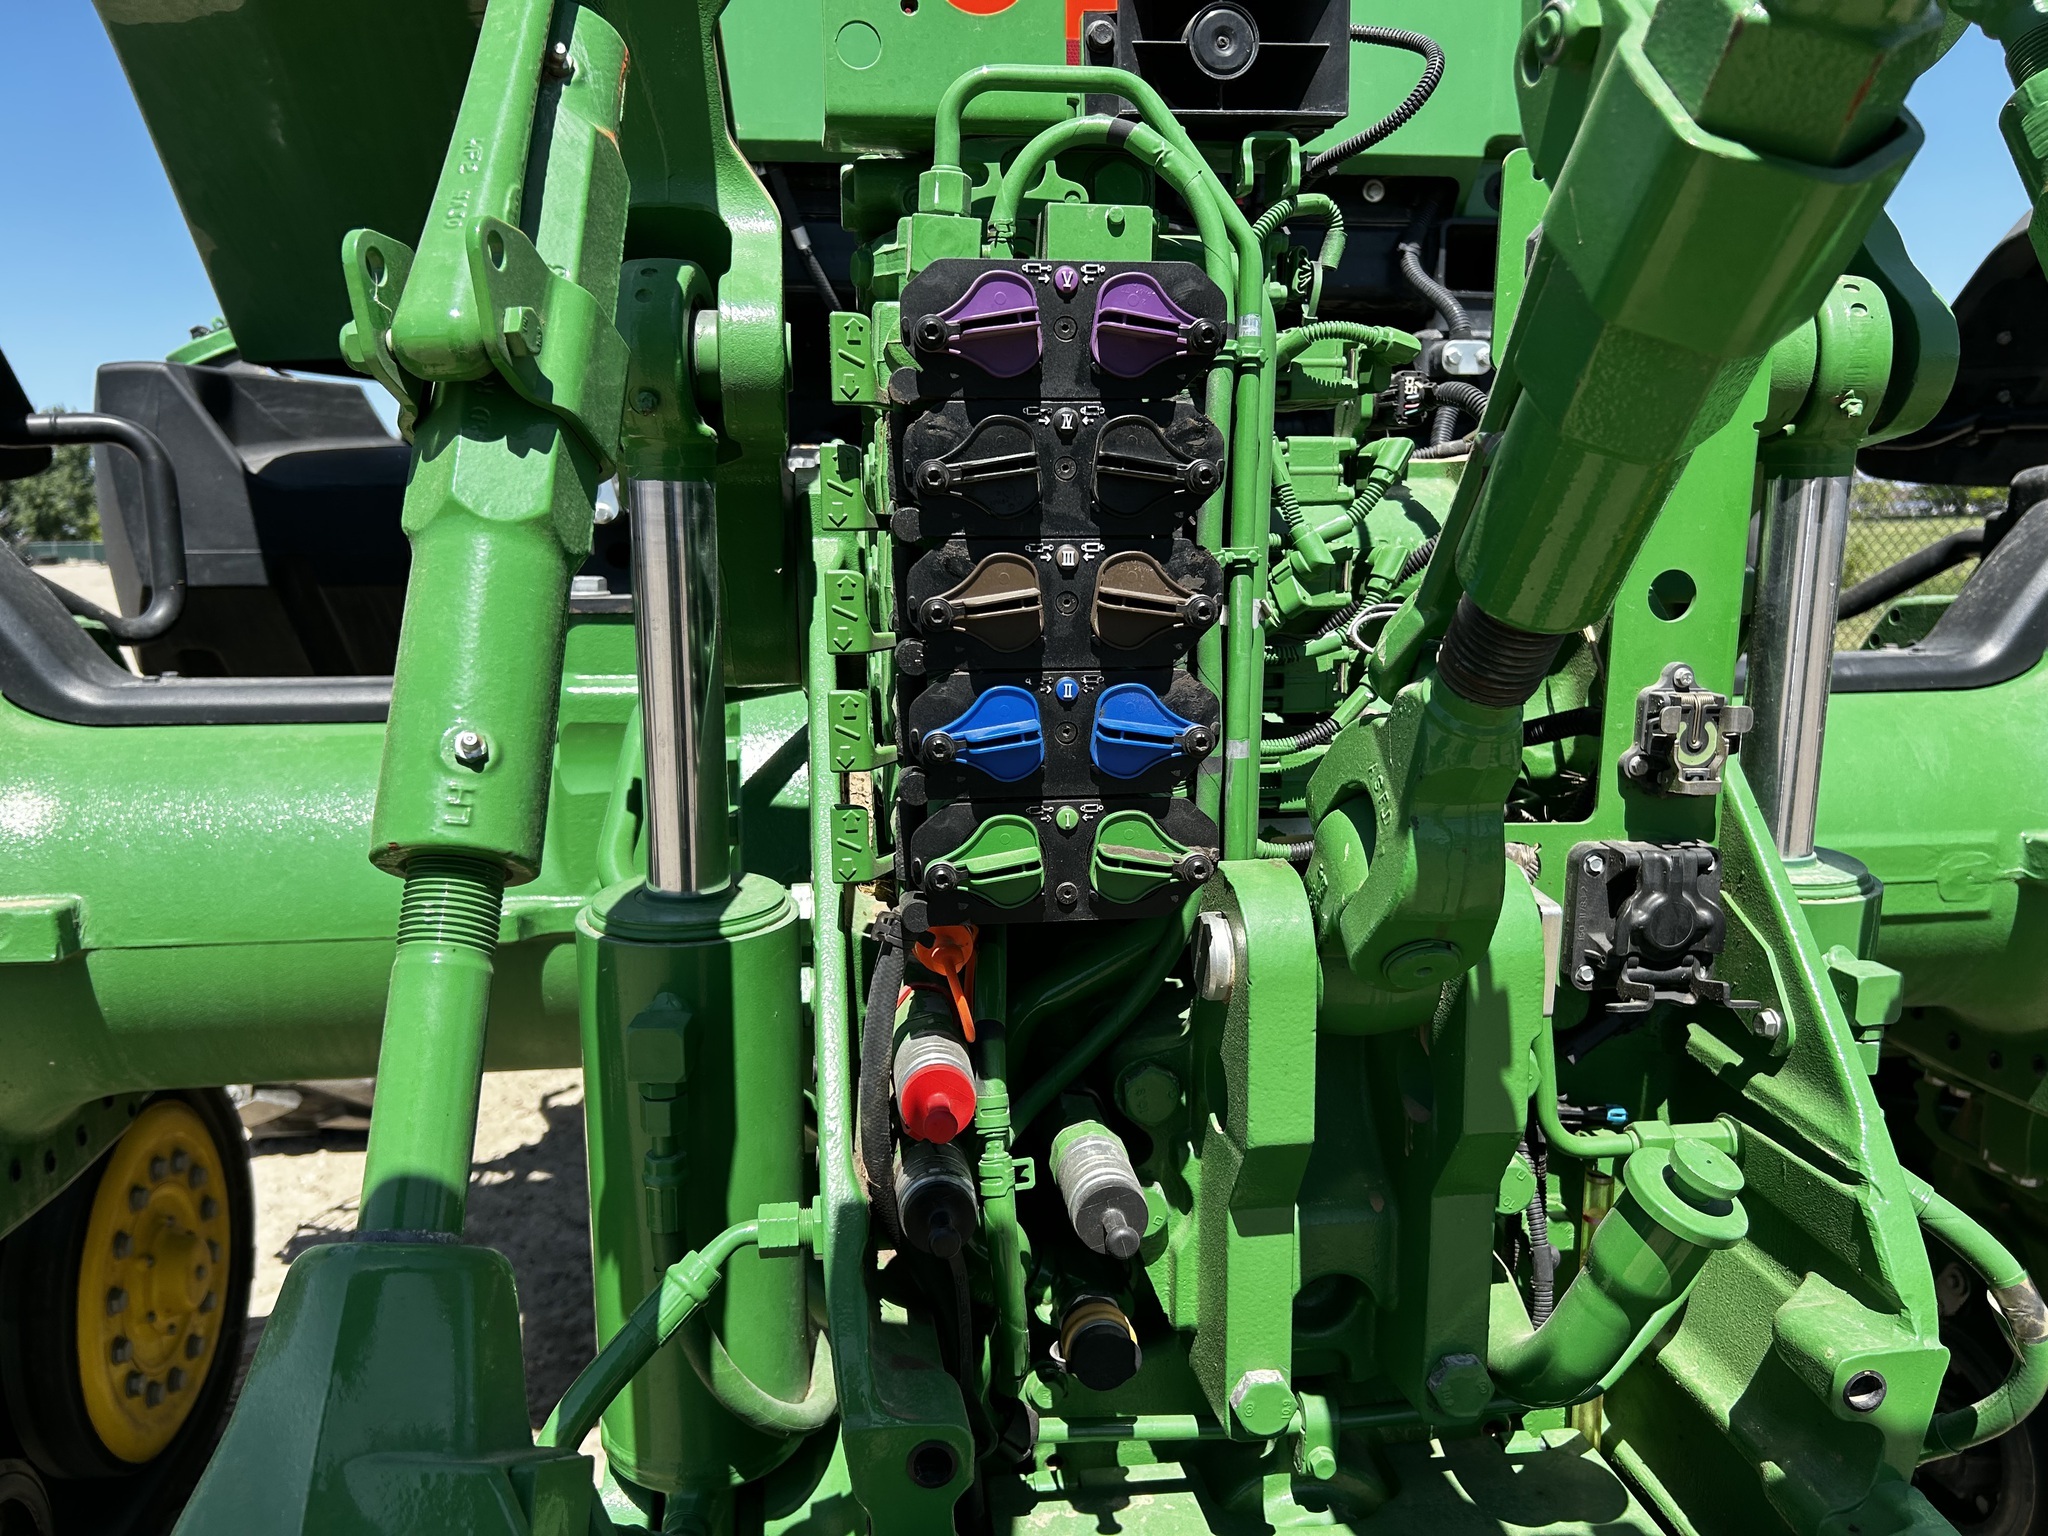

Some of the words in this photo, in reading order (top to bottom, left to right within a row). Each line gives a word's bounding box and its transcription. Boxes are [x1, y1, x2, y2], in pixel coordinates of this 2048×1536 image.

[1061, 270, 1074, 288] V
[1060, 413, 1074, 430] IV
[1061, 550, 1075, 567] III
[1063, 683, 1073, 698] II
